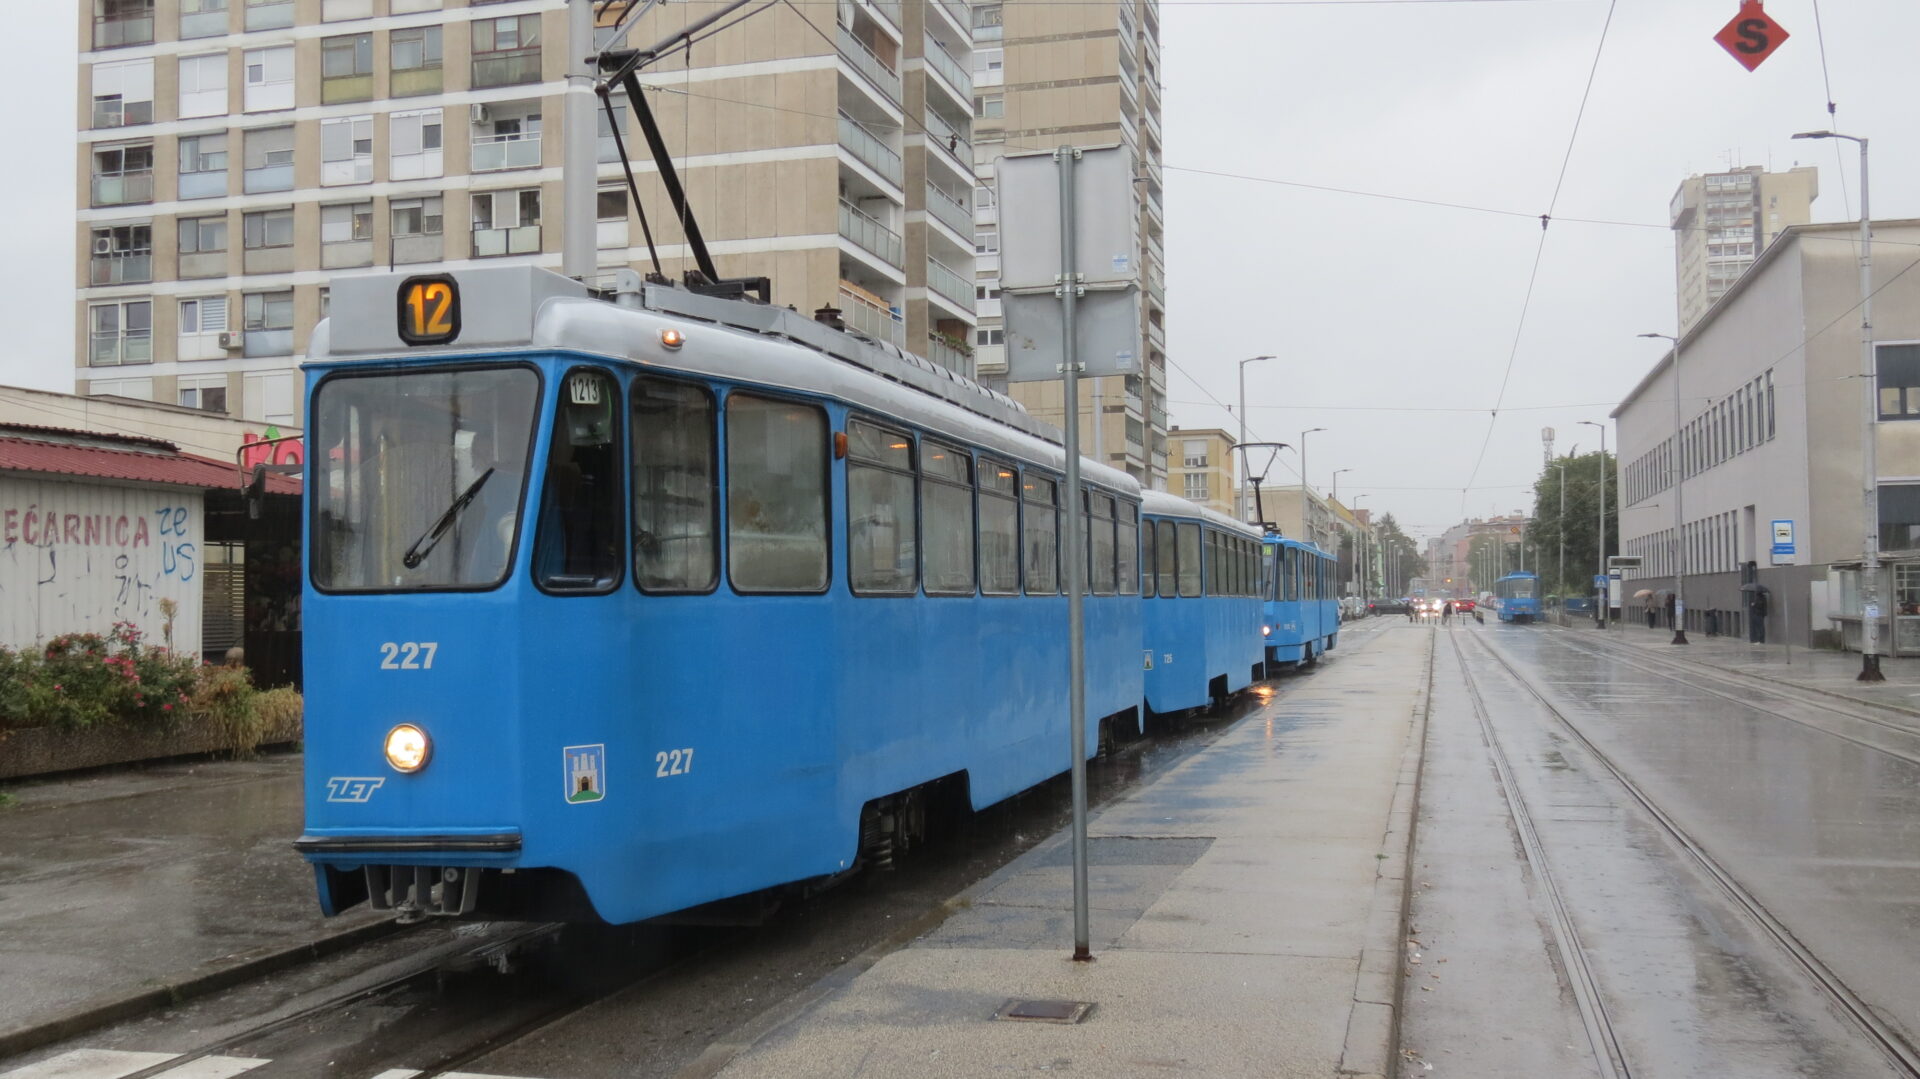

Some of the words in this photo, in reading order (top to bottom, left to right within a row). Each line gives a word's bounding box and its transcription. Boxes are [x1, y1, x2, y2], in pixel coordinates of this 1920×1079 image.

[1735, 18, 1769, 54] S
[407, 283, 452, 336] 12
[571, 378, 599, 401] 1213
[380, 641, 438, 670] 227
[656, 748, 694, 778] 227
[326, 776, 386, 803] ZET
